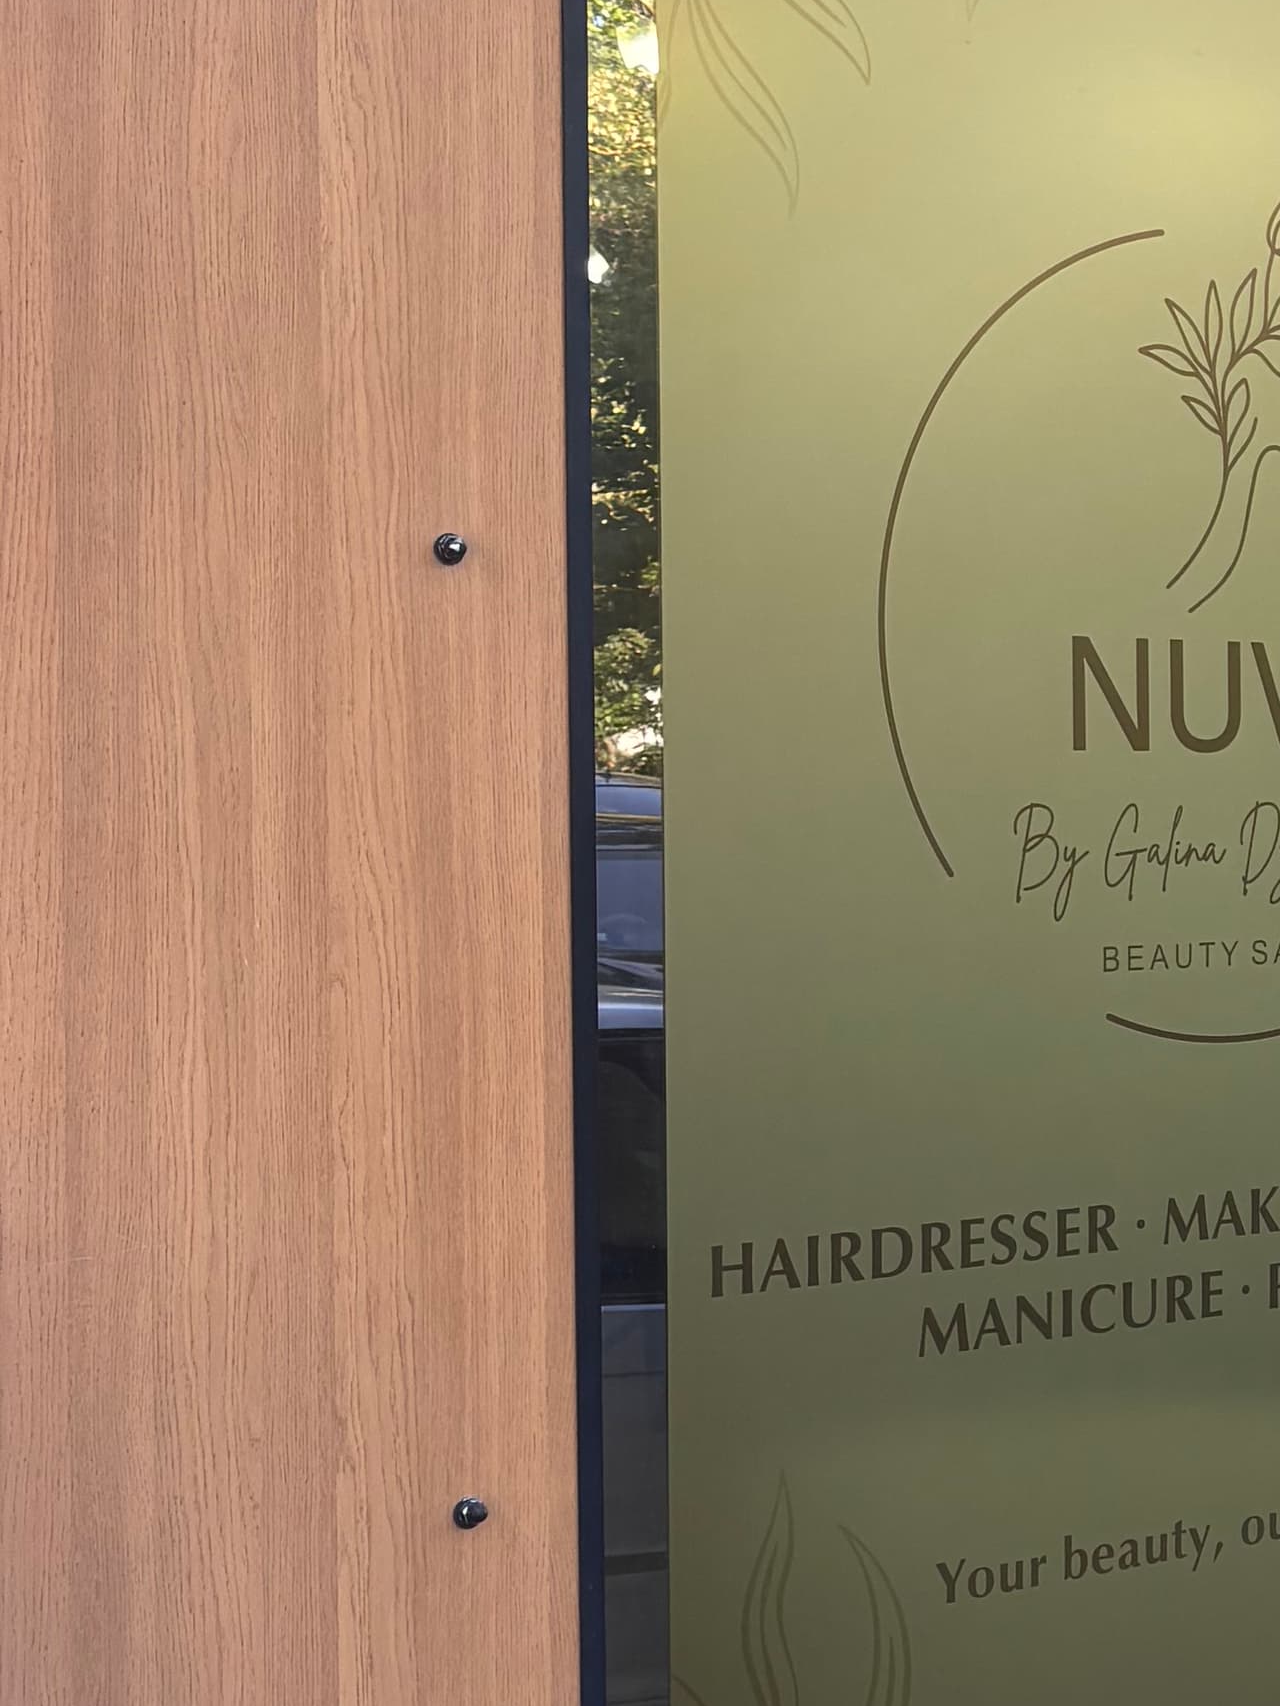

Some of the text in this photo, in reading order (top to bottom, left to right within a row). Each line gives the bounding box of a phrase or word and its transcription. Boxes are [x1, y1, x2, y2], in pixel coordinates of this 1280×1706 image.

[1014, 802, 1090, 922] By
[1105, 803, 1226, 901] Galina
[1102, 940, 1240, 973] BEAUTY
[711, 1204, 1119, 1298] HAIRDRESSER
[918, 1270, 1224, 1358] MANICURE
[936, 1552, 1047, 1604] Your
[1063, 1519, 1224, 1581] beauty,
